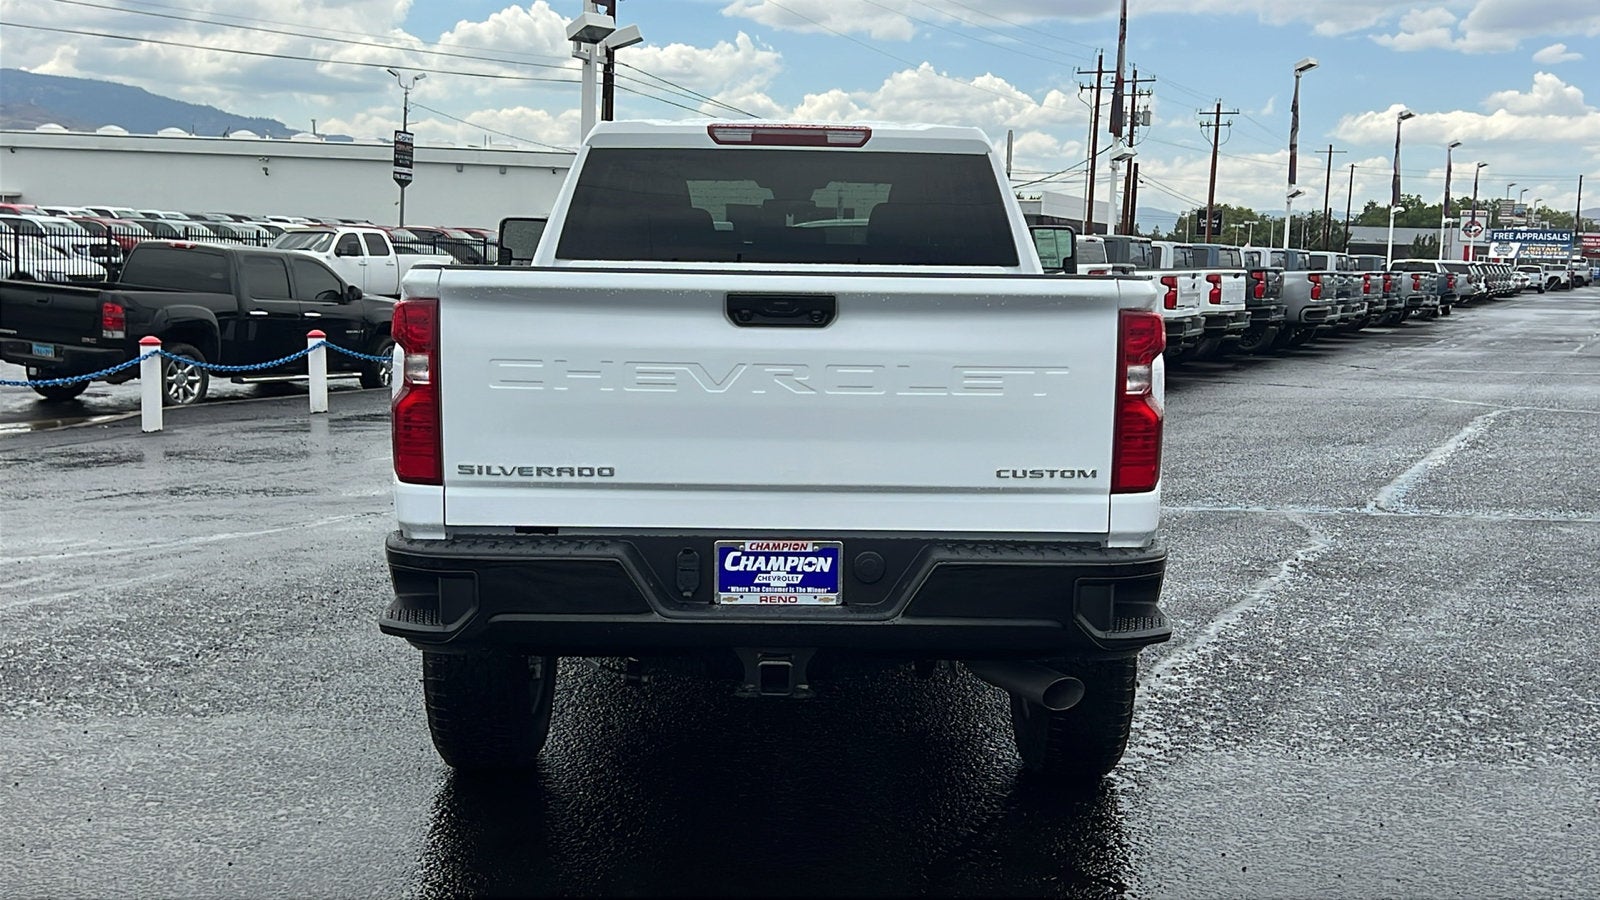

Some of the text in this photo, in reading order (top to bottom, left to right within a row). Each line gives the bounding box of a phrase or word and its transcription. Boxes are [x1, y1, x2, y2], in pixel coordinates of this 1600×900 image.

[1493, 232, 1571, 241] FREE APPRAISALS!
[488, 358, 1070, 397] CHEVROLET
[457, 464, 615, 477] SILVERADO
[996, 469, 1097, 479] CUSTOM
[749, 542, 809, 551] CHAMPION
[724, 551, 833, 572] CHAMPION
[759, 595, 798, 604] RENO
